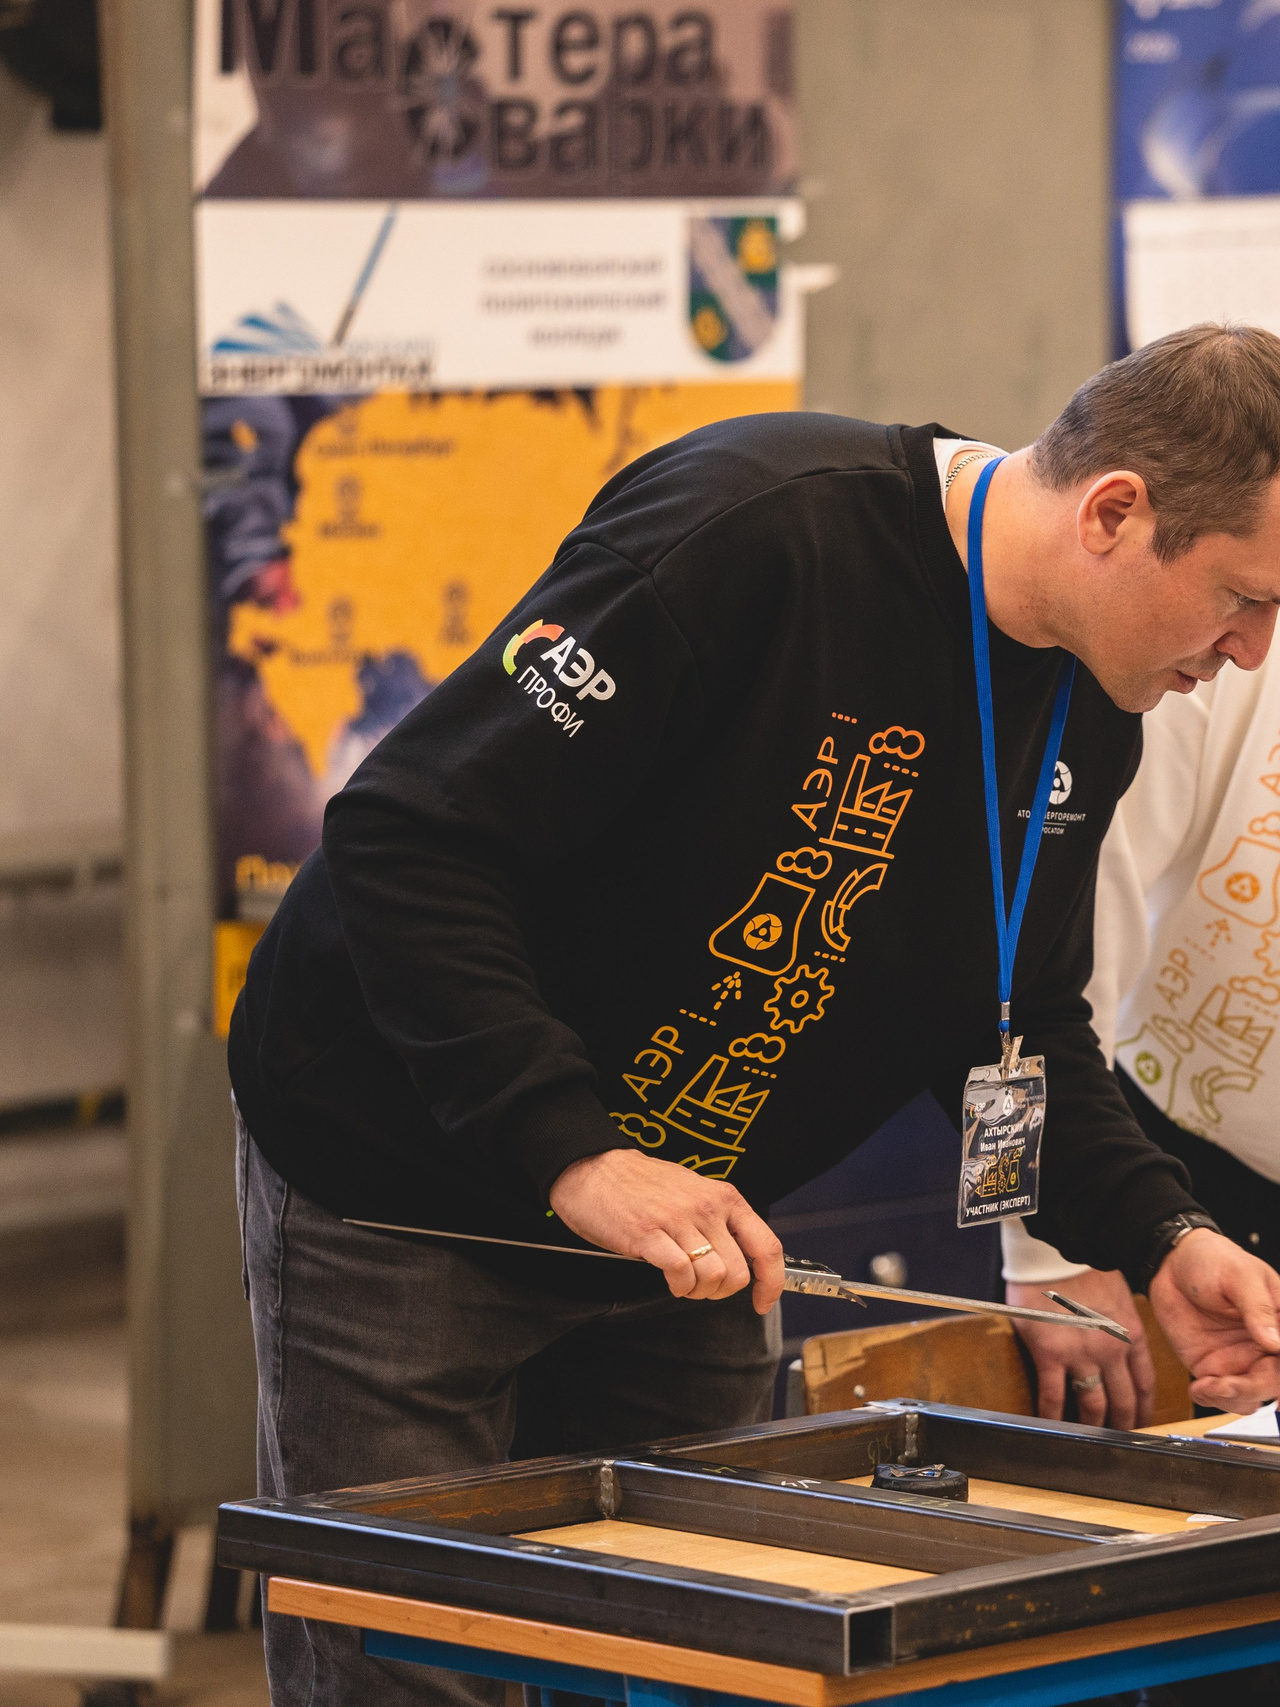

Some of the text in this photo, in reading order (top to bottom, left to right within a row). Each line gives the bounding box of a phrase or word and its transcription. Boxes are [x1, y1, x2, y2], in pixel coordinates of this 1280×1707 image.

[517, 665, 585, 738] ПРОФИ
[540, 636, 616, 701] АЭР
[791, 736, 838, 832] АЭР
[622, 1024, 685, 1103] АЭР
[981, 1141, 997, 1152] Иван
[965, 1195, 1031, 1217] УЧАСТНИК (ЭКСПЕРТ)
